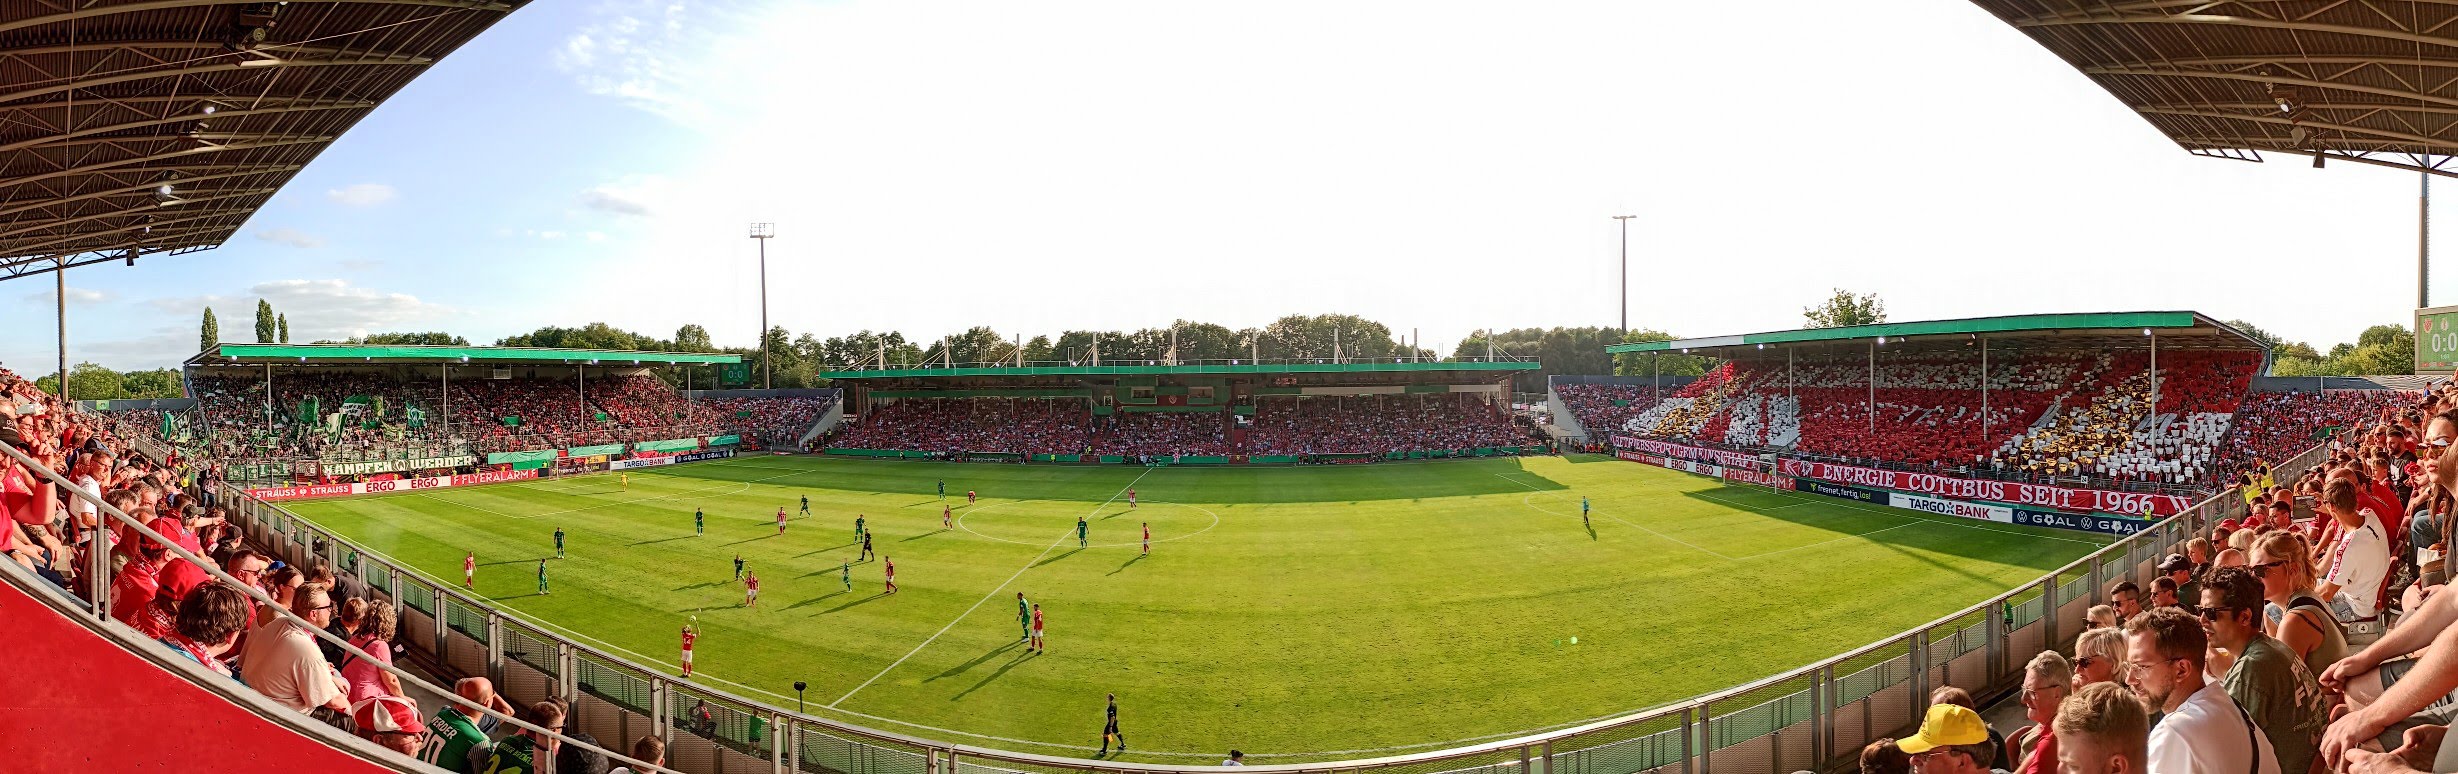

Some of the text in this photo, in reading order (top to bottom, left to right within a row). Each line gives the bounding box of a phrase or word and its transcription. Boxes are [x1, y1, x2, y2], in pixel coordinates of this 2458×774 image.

[2432, 332, 2457, 352] 0:0
[728, 370, 743, 379] 0:0
[410, 455, 473, 469] WERDER
[1645, 456, 1664, 465] STRAUSS
[1671, 459, 1714, 475] ERGO ERGO
[461, 470, 529, 485] FLYERALARM
[256, 485, 348, 498] STRAUSS STRAUSS
[366, 478, 439, 493] ERGO ERGO
[1823, 464, 2155, 516] ENERGIE COTTBUS SEIT 1966
[2032, 514, 2076, 527] GOAL
[430, 716, 458, 740] WERDER
